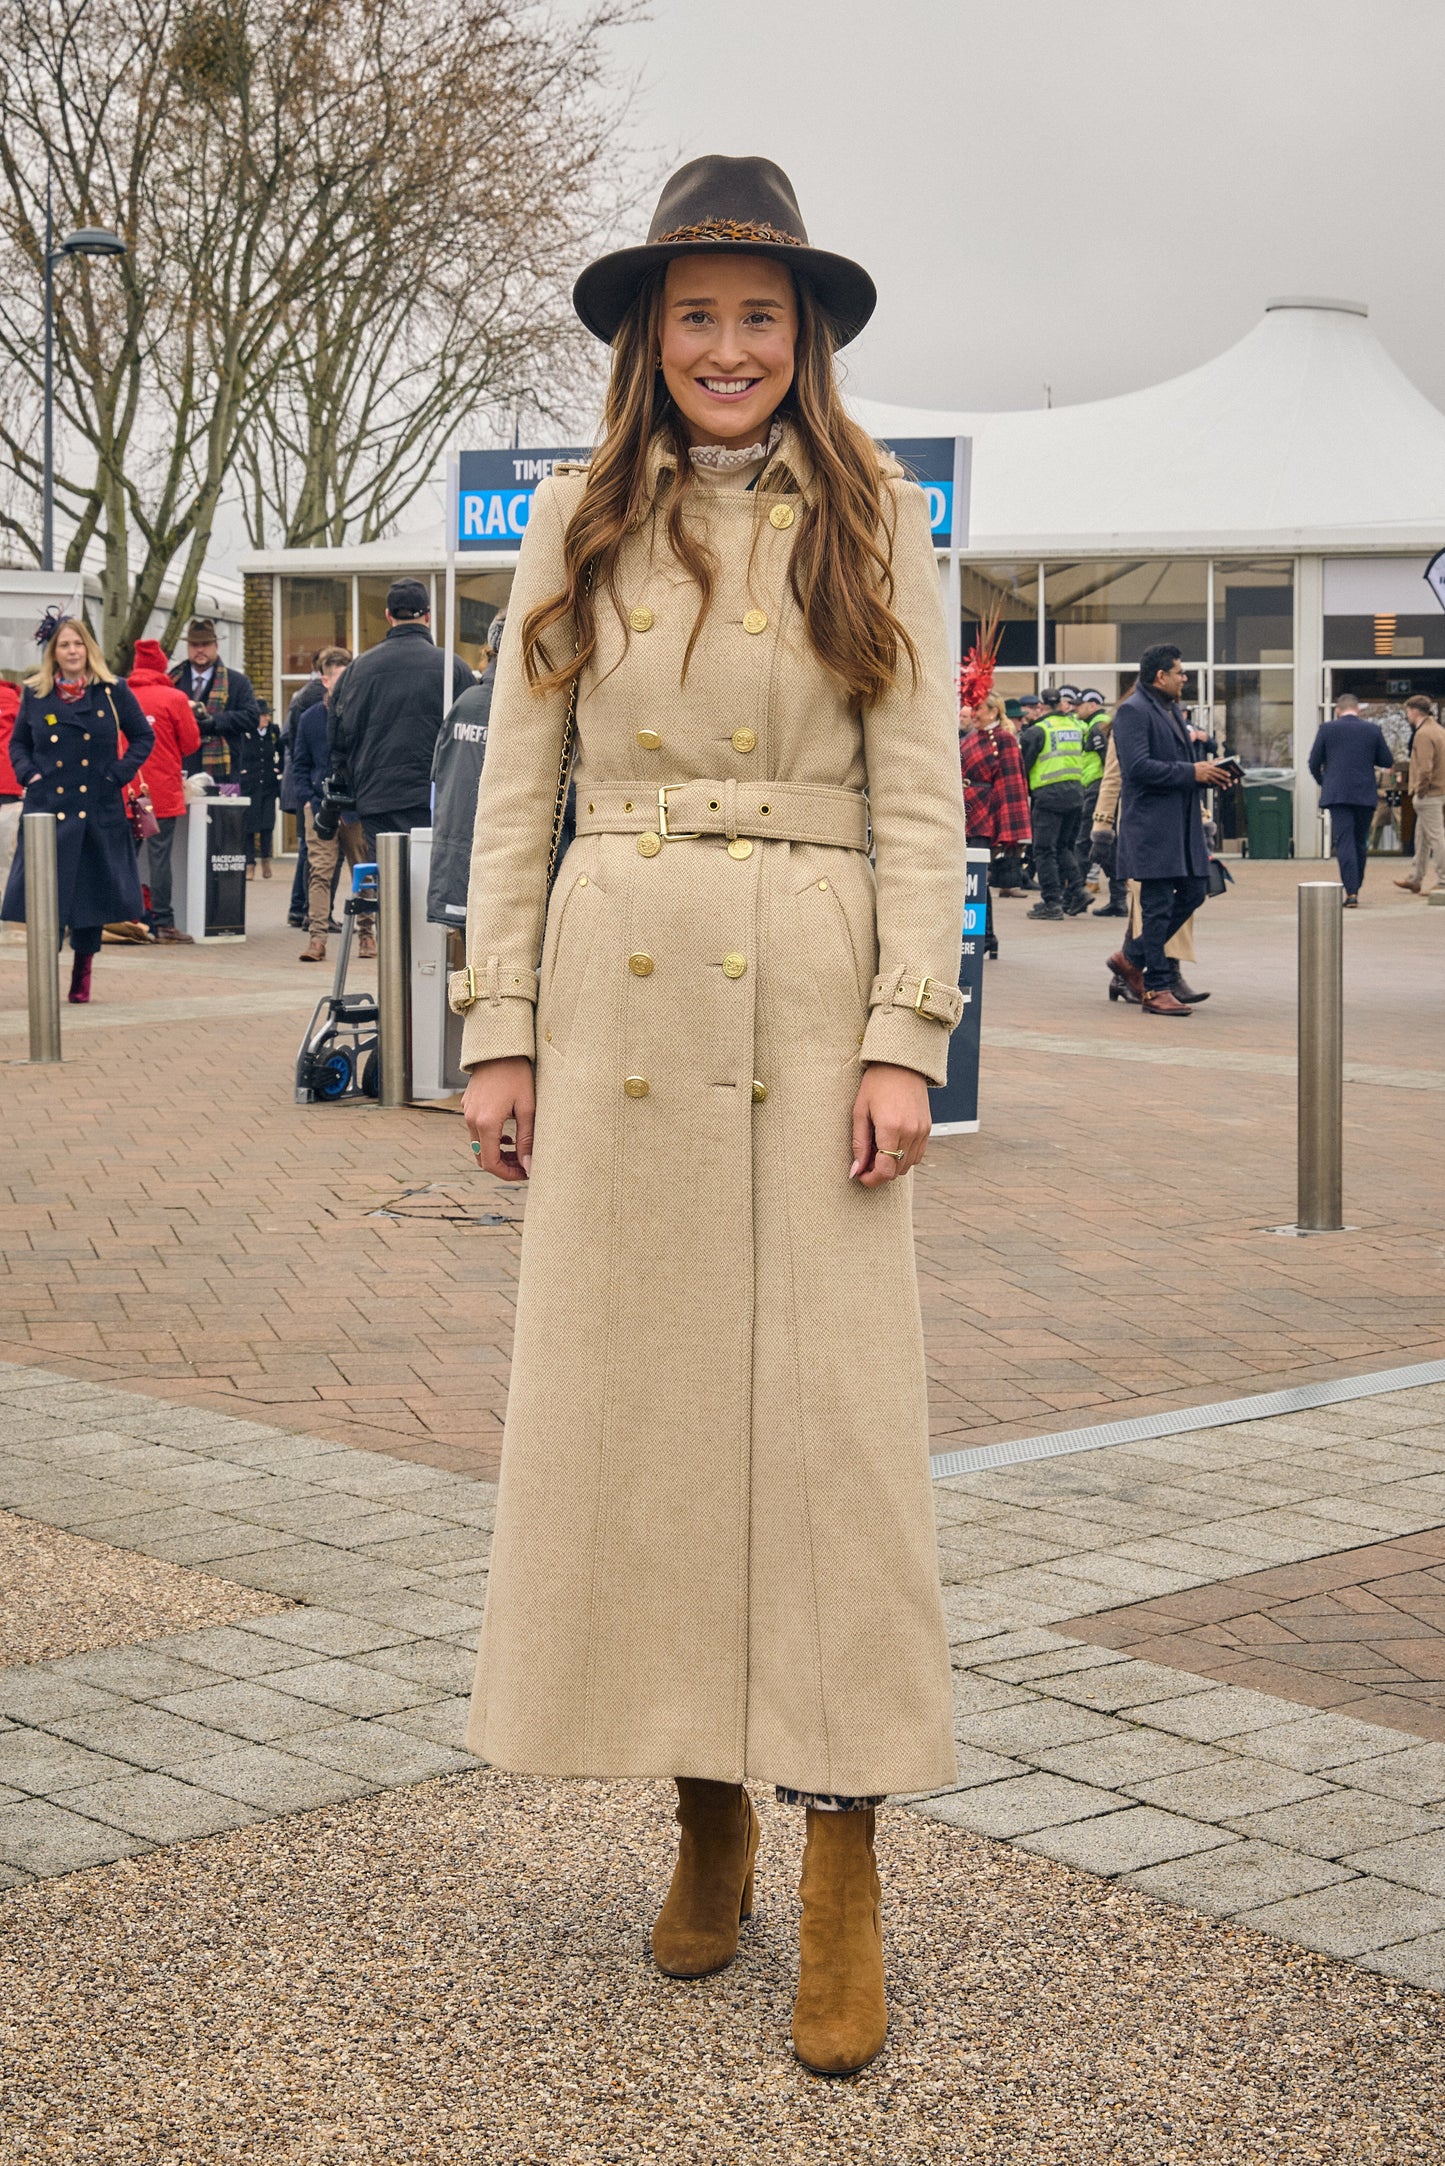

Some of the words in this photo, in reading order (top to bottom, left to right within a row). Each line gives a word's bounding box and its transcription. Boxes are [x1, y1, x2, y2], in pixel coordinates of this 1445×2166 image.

[512, 459, 592, 480] TIME
[464, 494, 534, 535] RAC
[211, 854, 246, 863] RACECARDS
[212, 862, 229, 871] SOLD
[229, 862, 246, 871] HERE
[963, 909, 976, 930] RD
[961, 942, 975, 955] ERE
